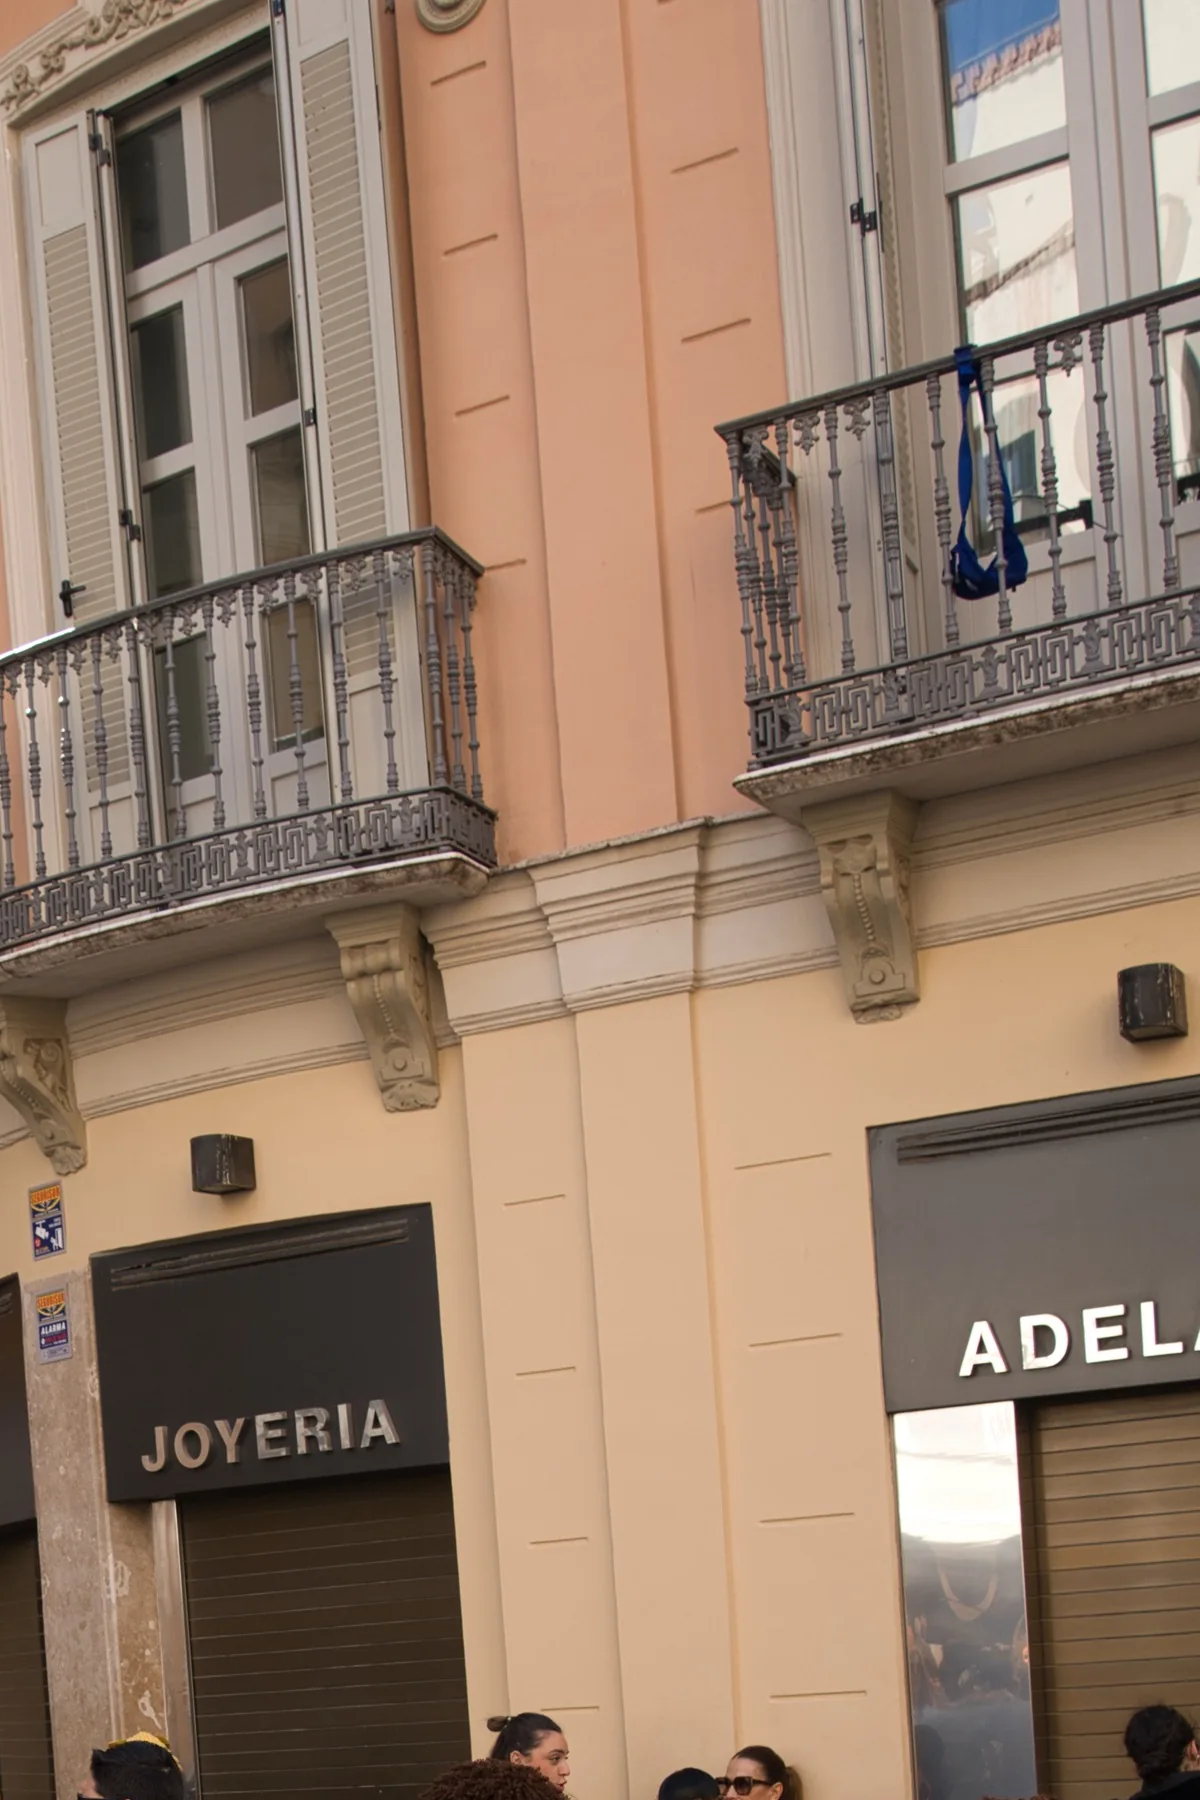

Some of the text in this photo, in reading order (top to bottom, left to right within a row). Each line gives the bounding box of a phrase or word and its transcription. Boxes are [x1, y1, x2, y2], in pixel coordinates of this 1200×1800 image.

[40, 1322, 66, 1335] ALARMA
[958, 1300, 1200, 1377] ADEL
[140, 1399, 400, 1473] JOYERIA
